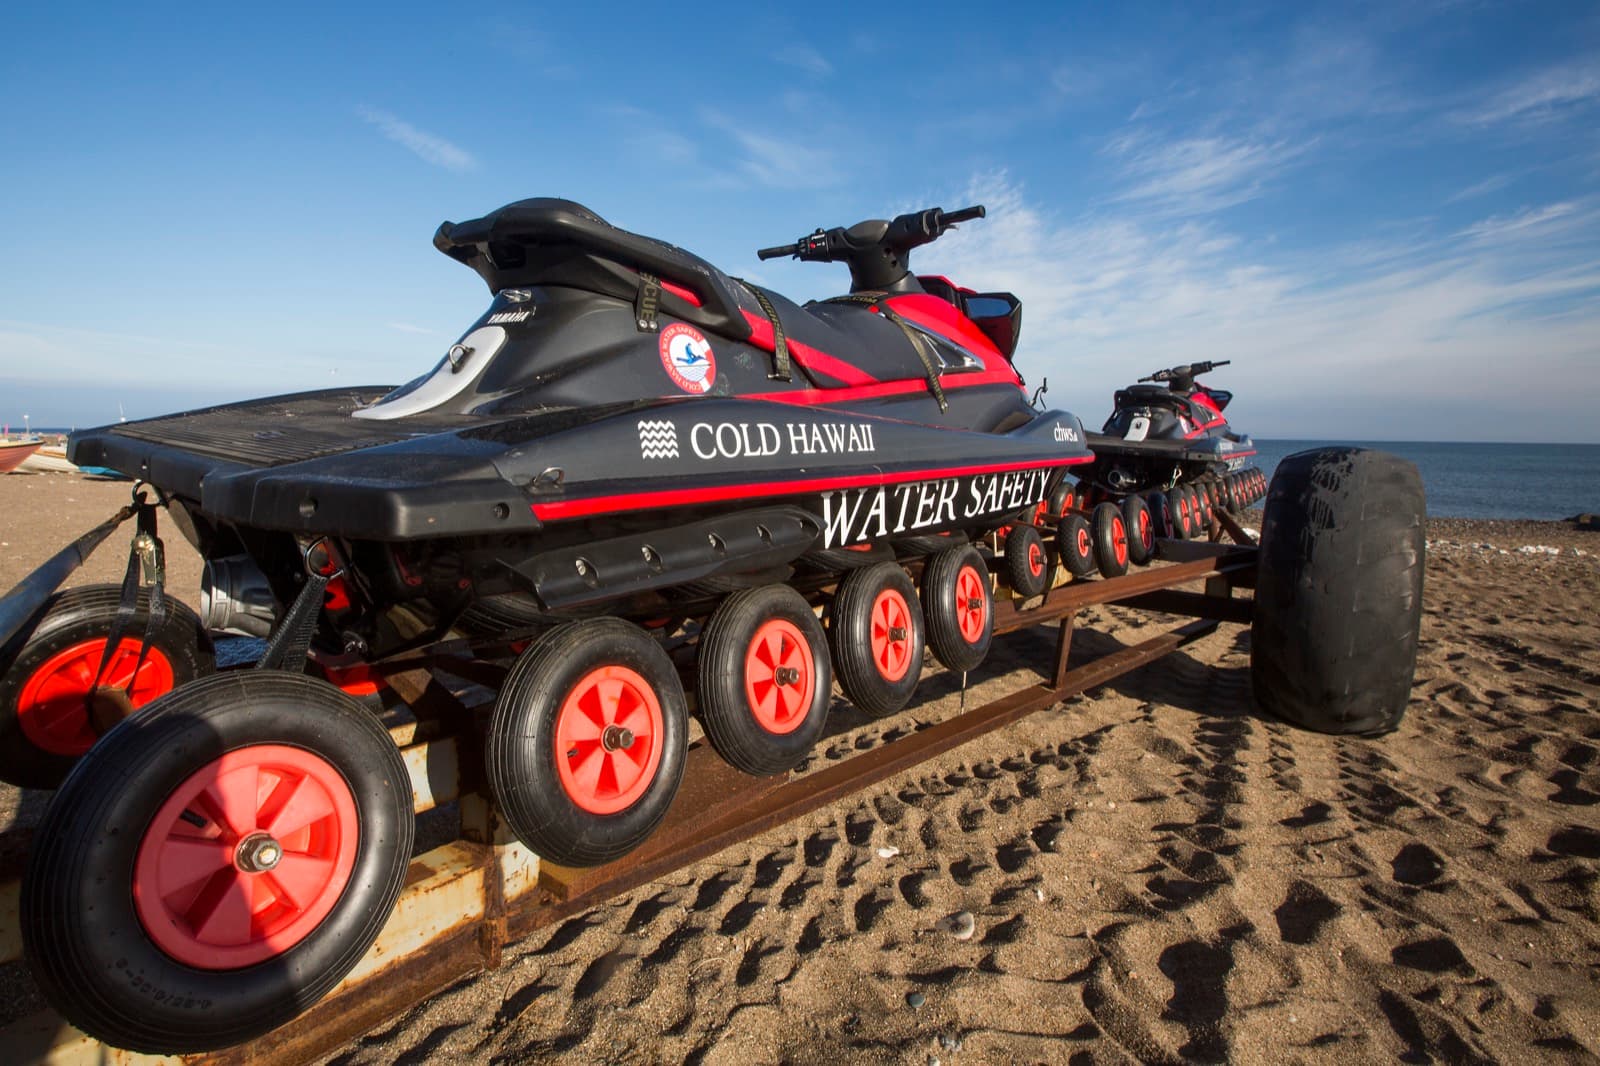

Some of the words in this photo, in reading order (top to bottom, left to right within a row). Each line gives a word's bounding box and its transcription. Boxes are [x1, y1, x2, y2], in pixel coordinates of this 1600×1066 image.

[487, 311, 529, 324] YAMAHA
[662, 327, 676, 349] WATER
[675, 326, 703, 341] SAFETY
[690, 422, 781, 459] COLD
[786, 423, 875, 454] HAWAII
[821, 477, 959, 550] WATER
[963, 467, 1053, 518] SAFETY
